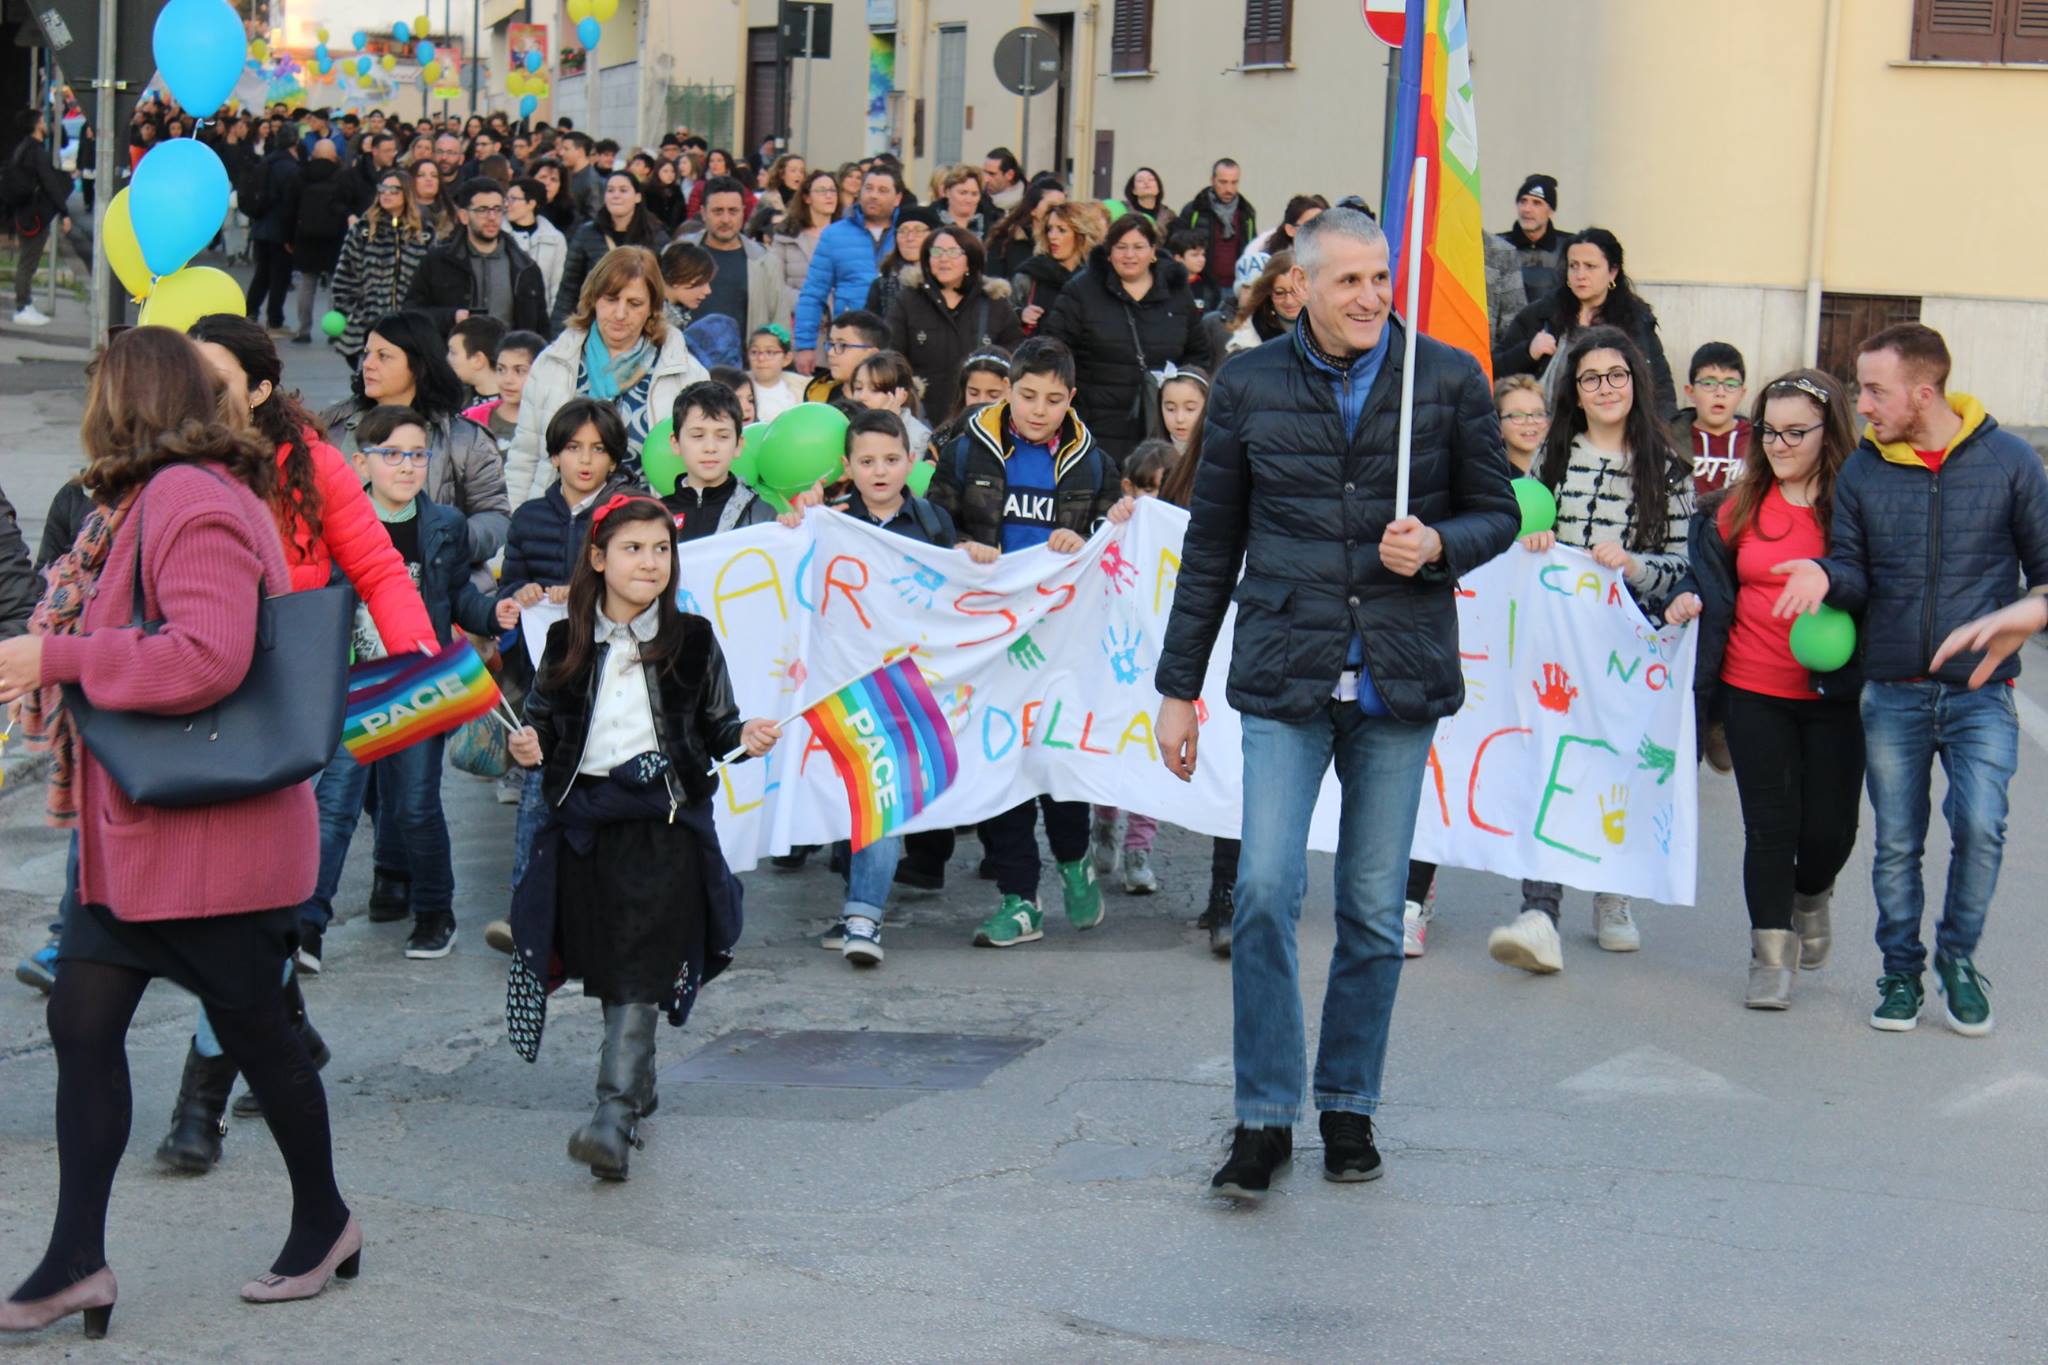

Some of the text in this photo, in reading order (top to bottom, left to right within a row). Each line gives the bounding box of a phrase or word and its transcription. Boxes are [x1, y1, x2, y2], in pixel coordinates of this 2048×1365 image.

[1003, 493, 1056, 522] ALKI
[360, 672, 470, 737] PACE
[982, 698, 1158, 762] DELLA
[844, 707, 898, 815] PACE
